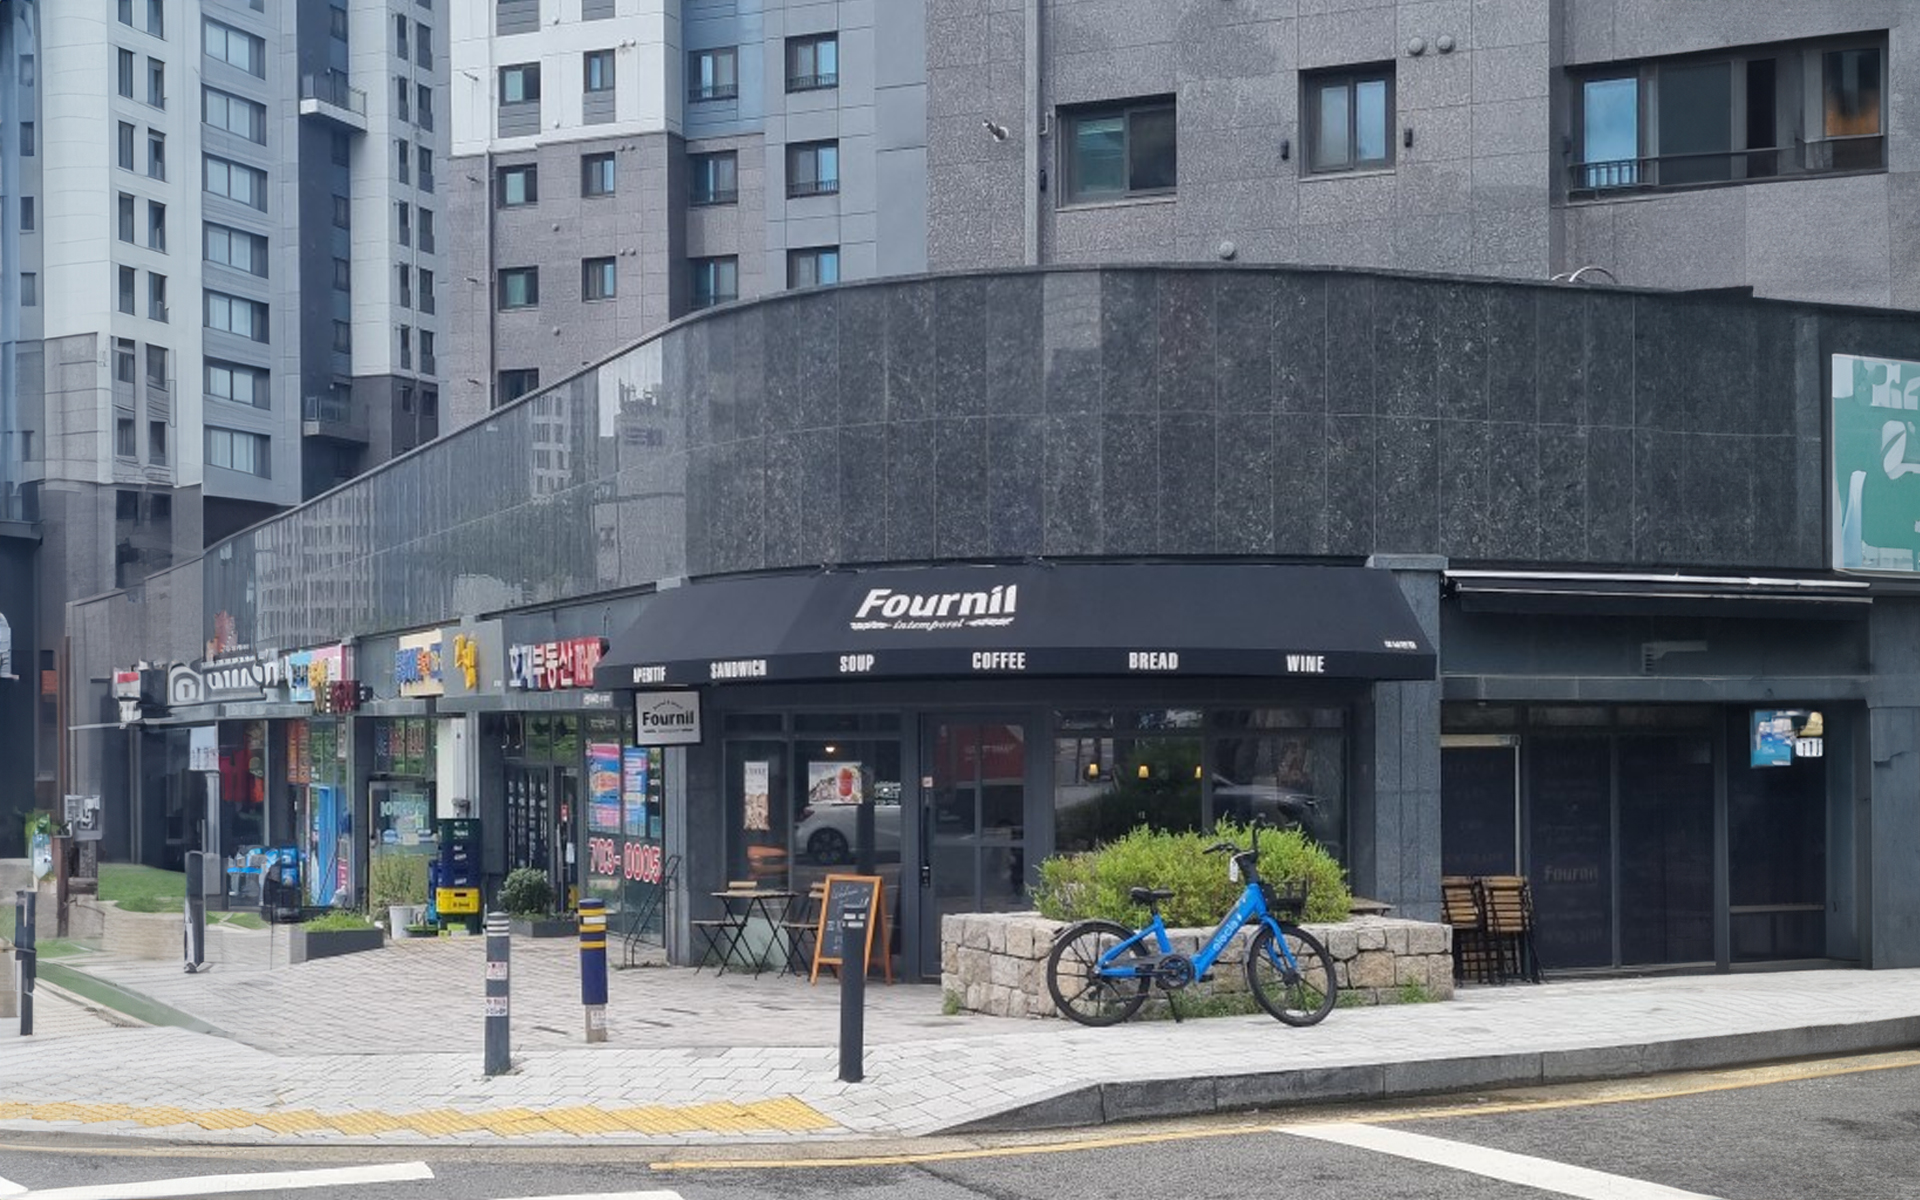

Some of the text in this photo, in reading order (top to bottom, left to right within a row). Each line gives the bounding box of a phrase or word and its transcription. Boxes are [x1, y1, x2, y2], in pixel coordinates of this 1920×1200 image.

[855, 585, 1017, 618] Fournil
[710, 660, 766, 679] SANDWICH
[839, 654, 875, 672] SOUP
[972, 652, 1026, 670] COFFEE
[1129, 652, 1179, 670] BREAD
[1286, 655, 1325, 673] WINE
[642, 711, 695, 727] Fournil
